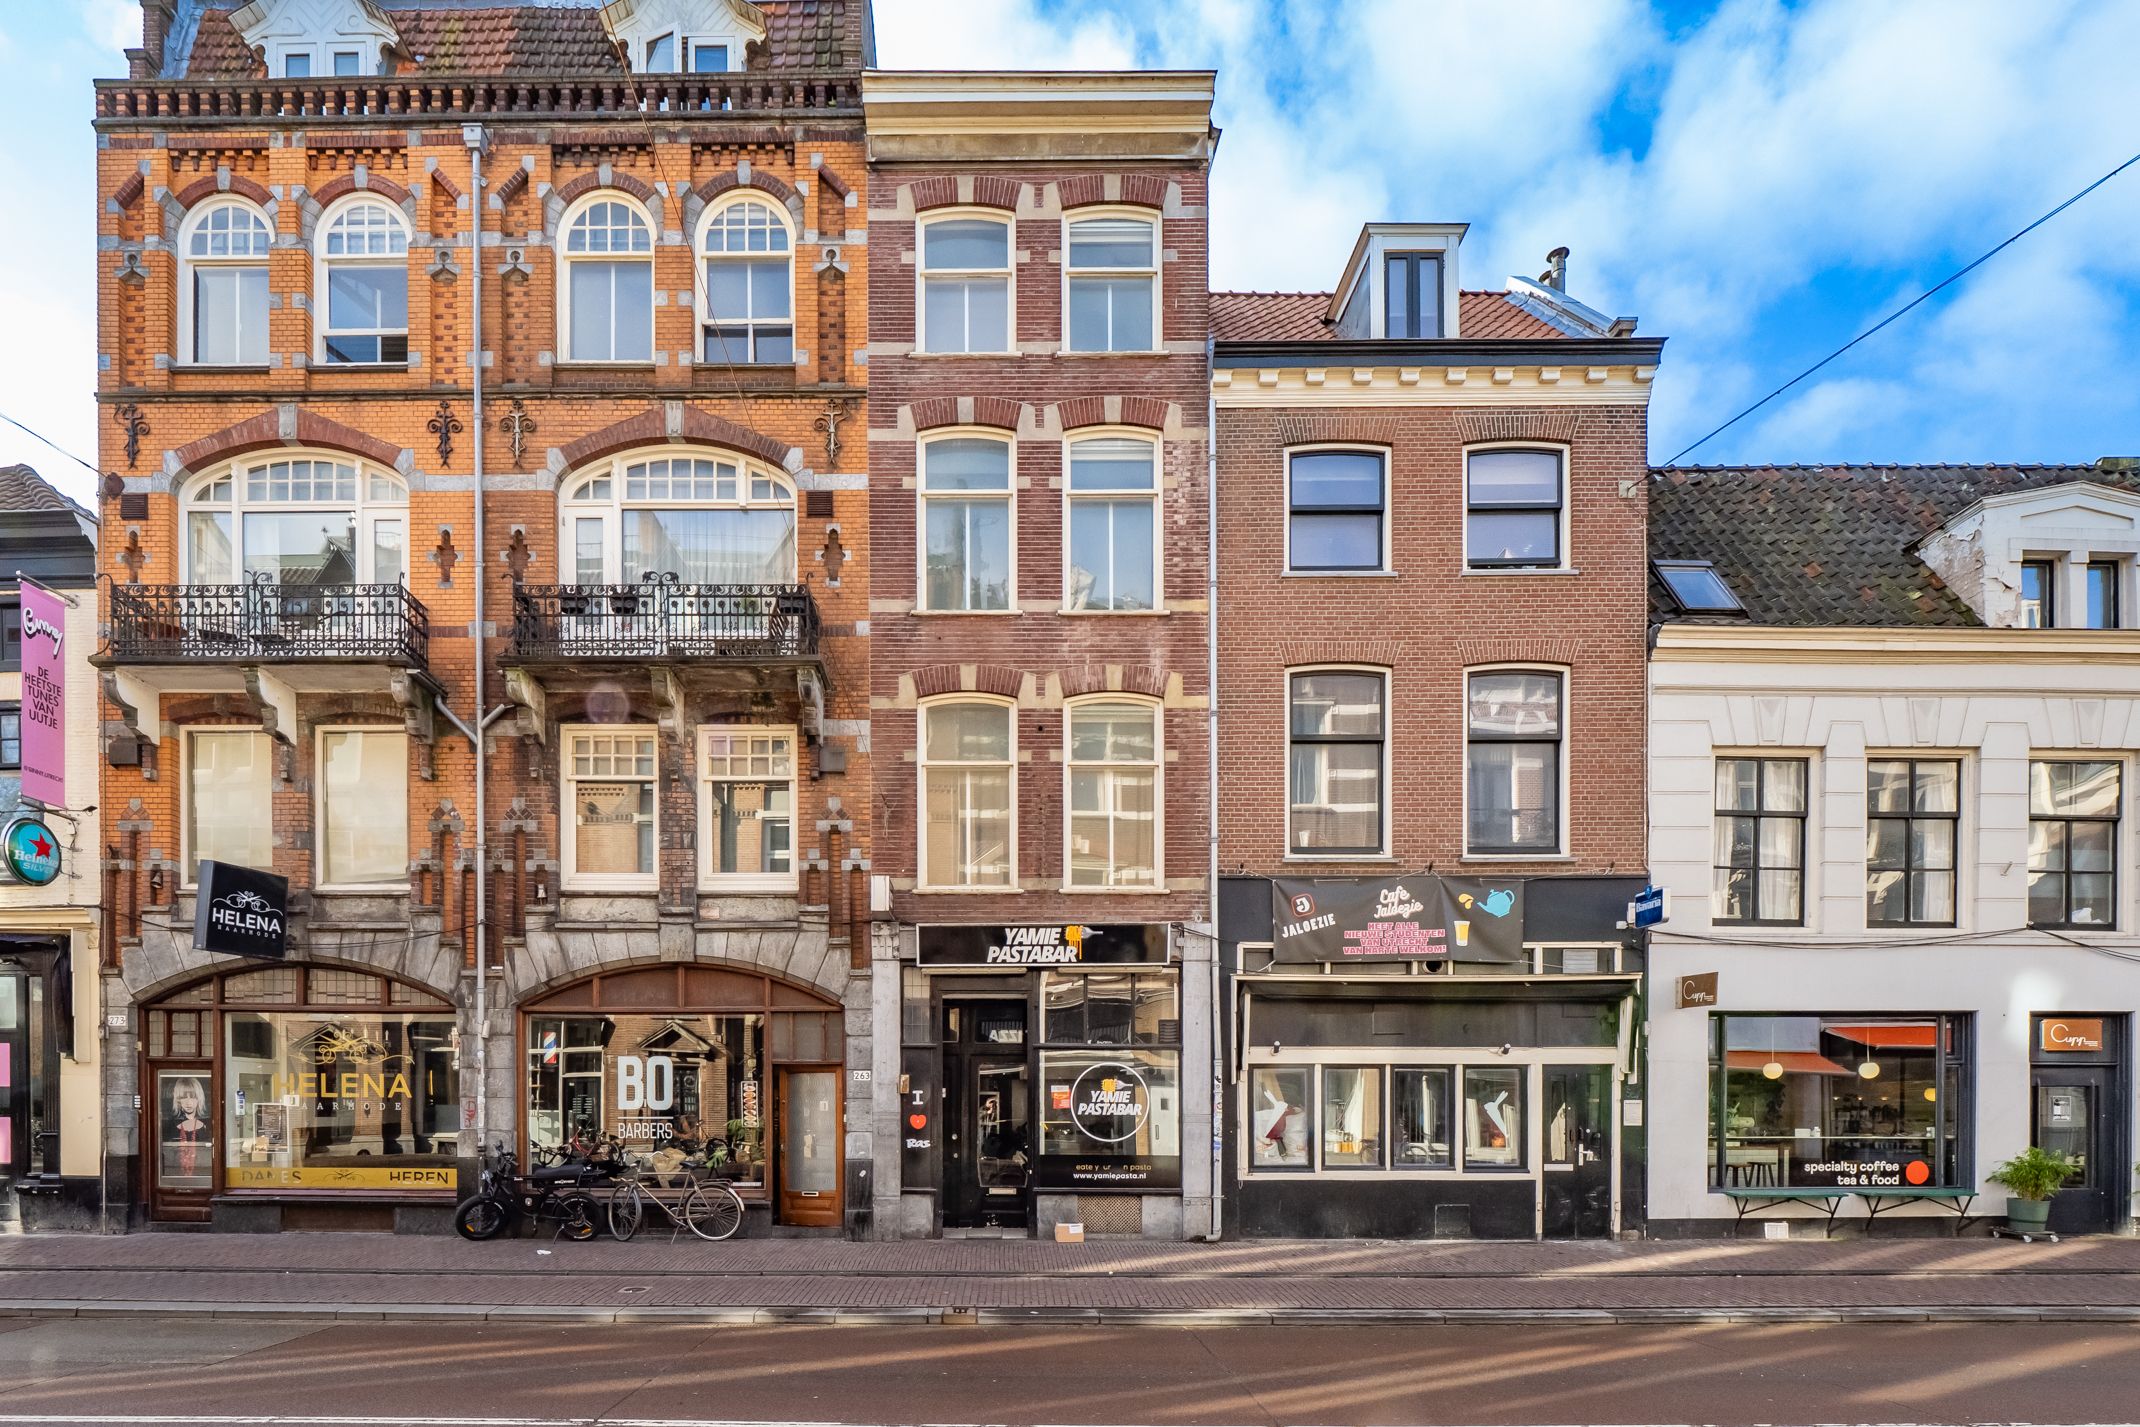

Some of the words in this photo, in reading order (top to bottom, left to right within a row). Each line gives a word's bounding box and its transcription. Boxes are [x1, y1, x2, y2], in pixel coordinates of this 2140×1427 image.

[38, 666, 49, 680] DE
[25, 672, 61, 697] HEETSTE
[28, 685, 59, 707] TUNES
[33, 698, 54, 716] VAN
[29, 709, 58, 729] UUTJE
[212, 907, 282, 934] HELENA
[1282, 913, 1336, 938] JALOEZIE
[1395, 921, 1419, 930] ALLE
[1005, 927, 1062, 945] YAMIE
[1344, 930, 1382, 938] NIEUWE
[1384, 929, 1445, 938] STUDENTEN
[1343, 946, 1363, 954] VAN
[1365, 946, 1398, 954] HARTE
[1400, 944, 1447, 953] WELKOM!
[1382, 938, 1428, 946] UTRECHT
[987, 946, 1077, 963] PASTABAR
[110, 1016, 125, 1025] 273
[618, 1055, 673, 1110] BO
[855, 1071, 870, 1080] 263
[273, 1073, 412, 1099] HELENA
[1090, 1090, 1131, 1103] YAMIE
[286, 1101, 402, 1111] AARMODE
[1077, 1103, 1142, 1116] PASTABAR
[618, 1122, 673, 1139] BARBERS
[1804, 1161, 1857, 1175] specialty
[1860, 1161, 1899, 1172] coffee
[389, 1171, 449, 1185] HEREN
[1073, 1172, 1147, 1181] www.yamiepasta.nl
[1837, 1175, 1857, 1185] tea
[1859, 1174, 1869, 1185] &
[1871, 1175, 1899, 1185] food
